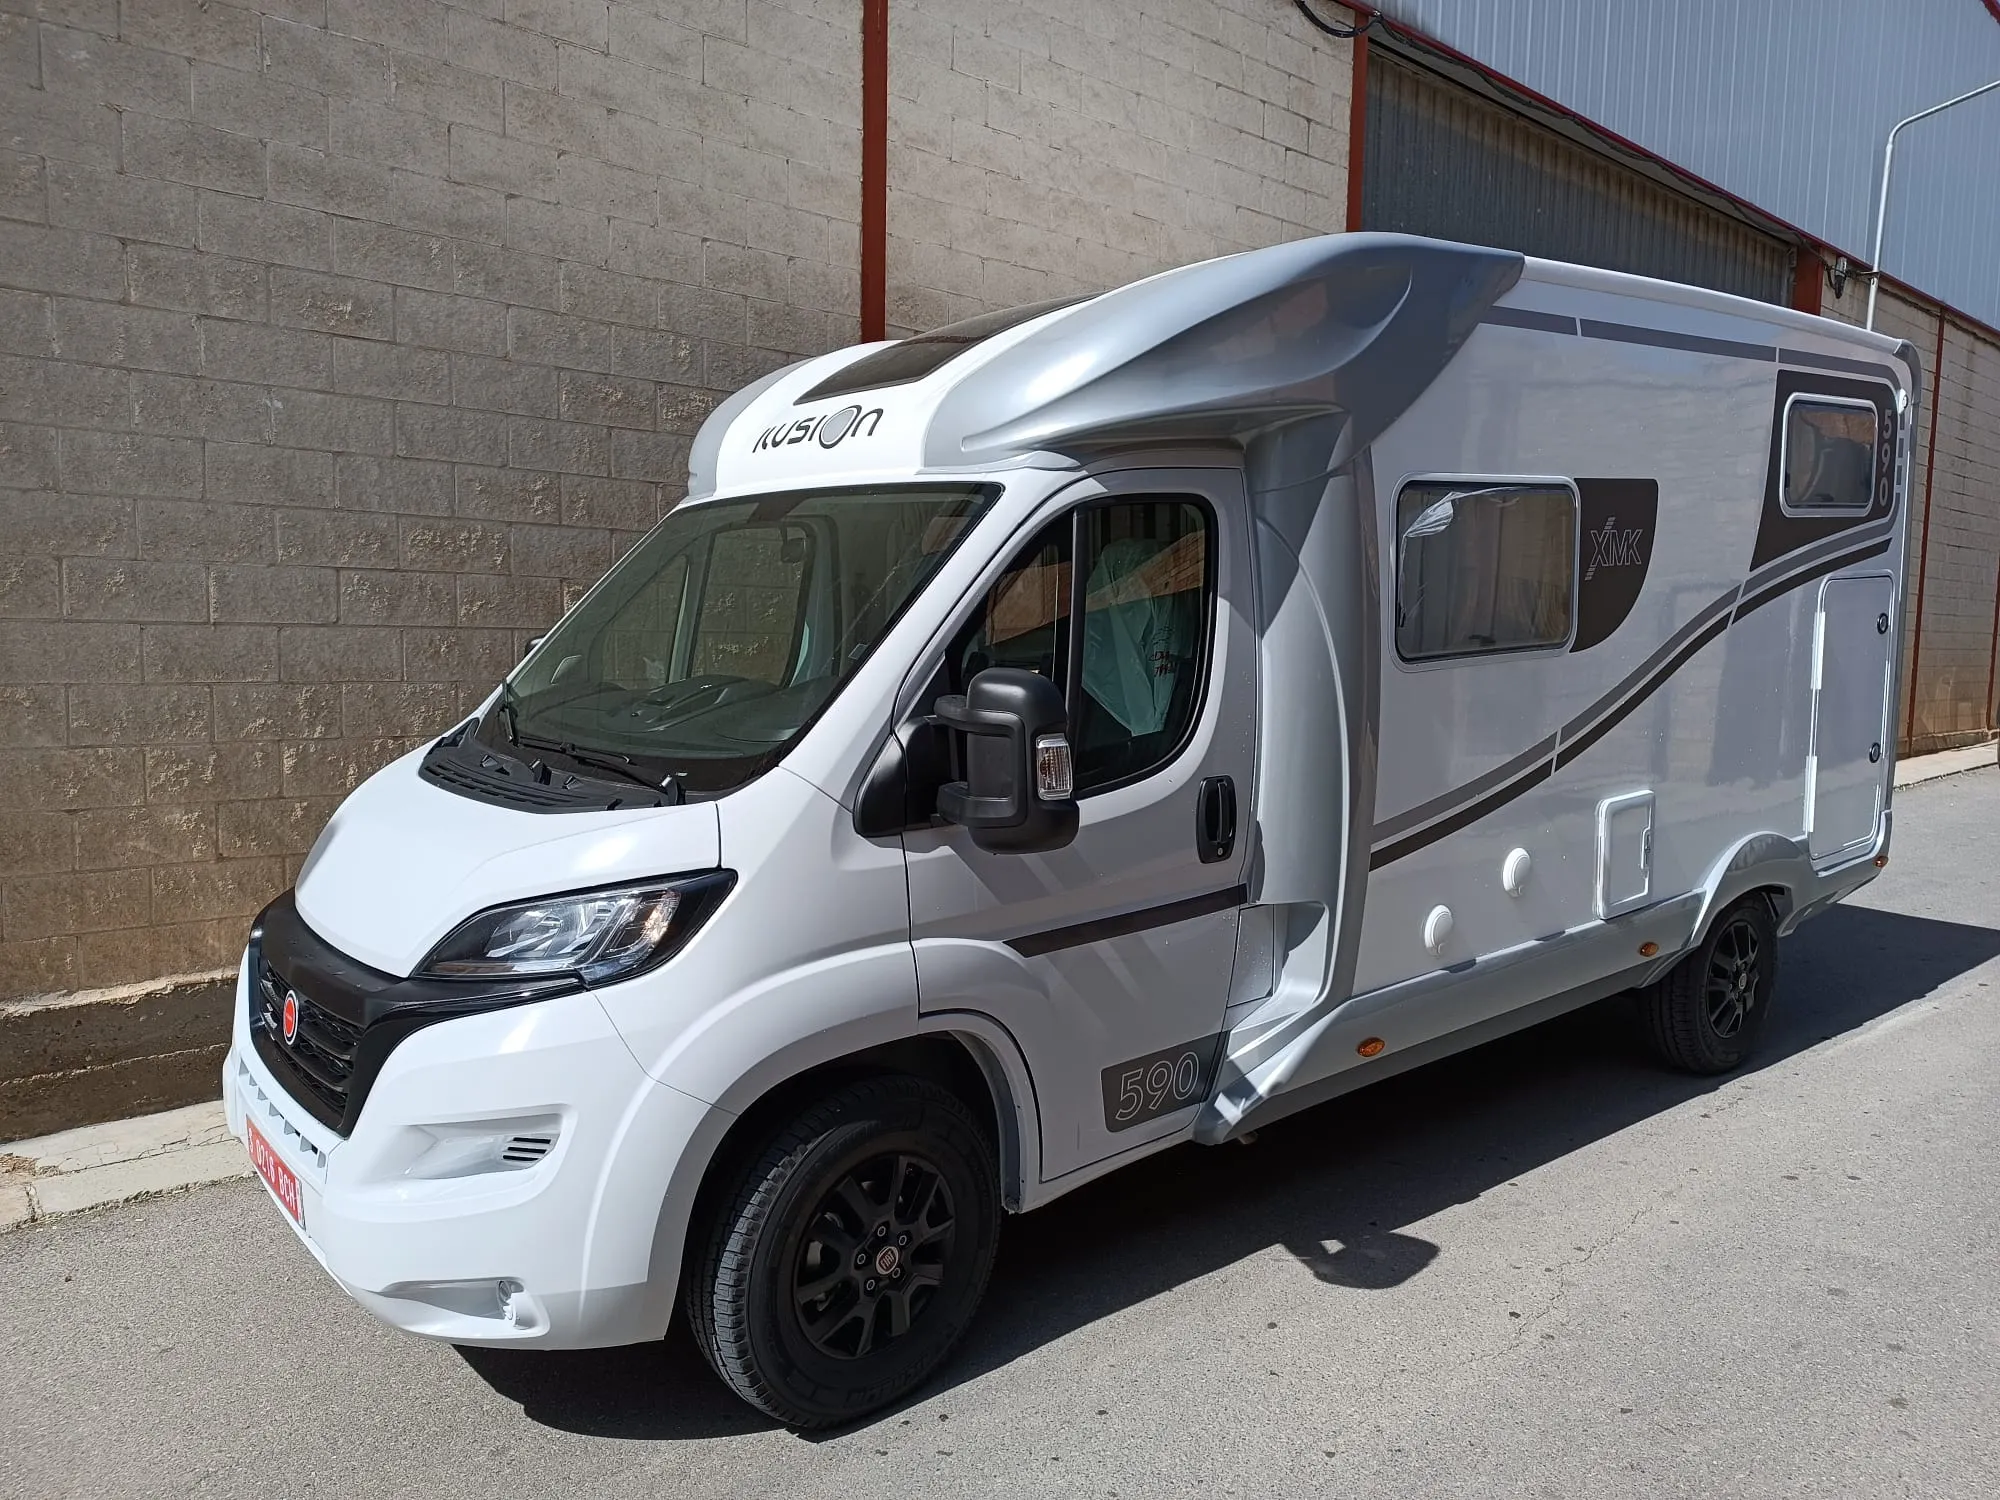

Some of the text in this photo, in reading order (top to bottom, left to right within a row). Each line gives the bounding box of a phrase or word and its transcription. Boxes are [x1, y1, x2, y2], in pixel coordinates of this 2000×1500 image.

[1879, 409, 1893, 507] 590
[1590, 528, 1643, 567] XMK
[1115, 1051, 1199, 1121] 590
[255, 1139, 275, 1184] 0216
[880, 1251, 895, 1270] FIAT
